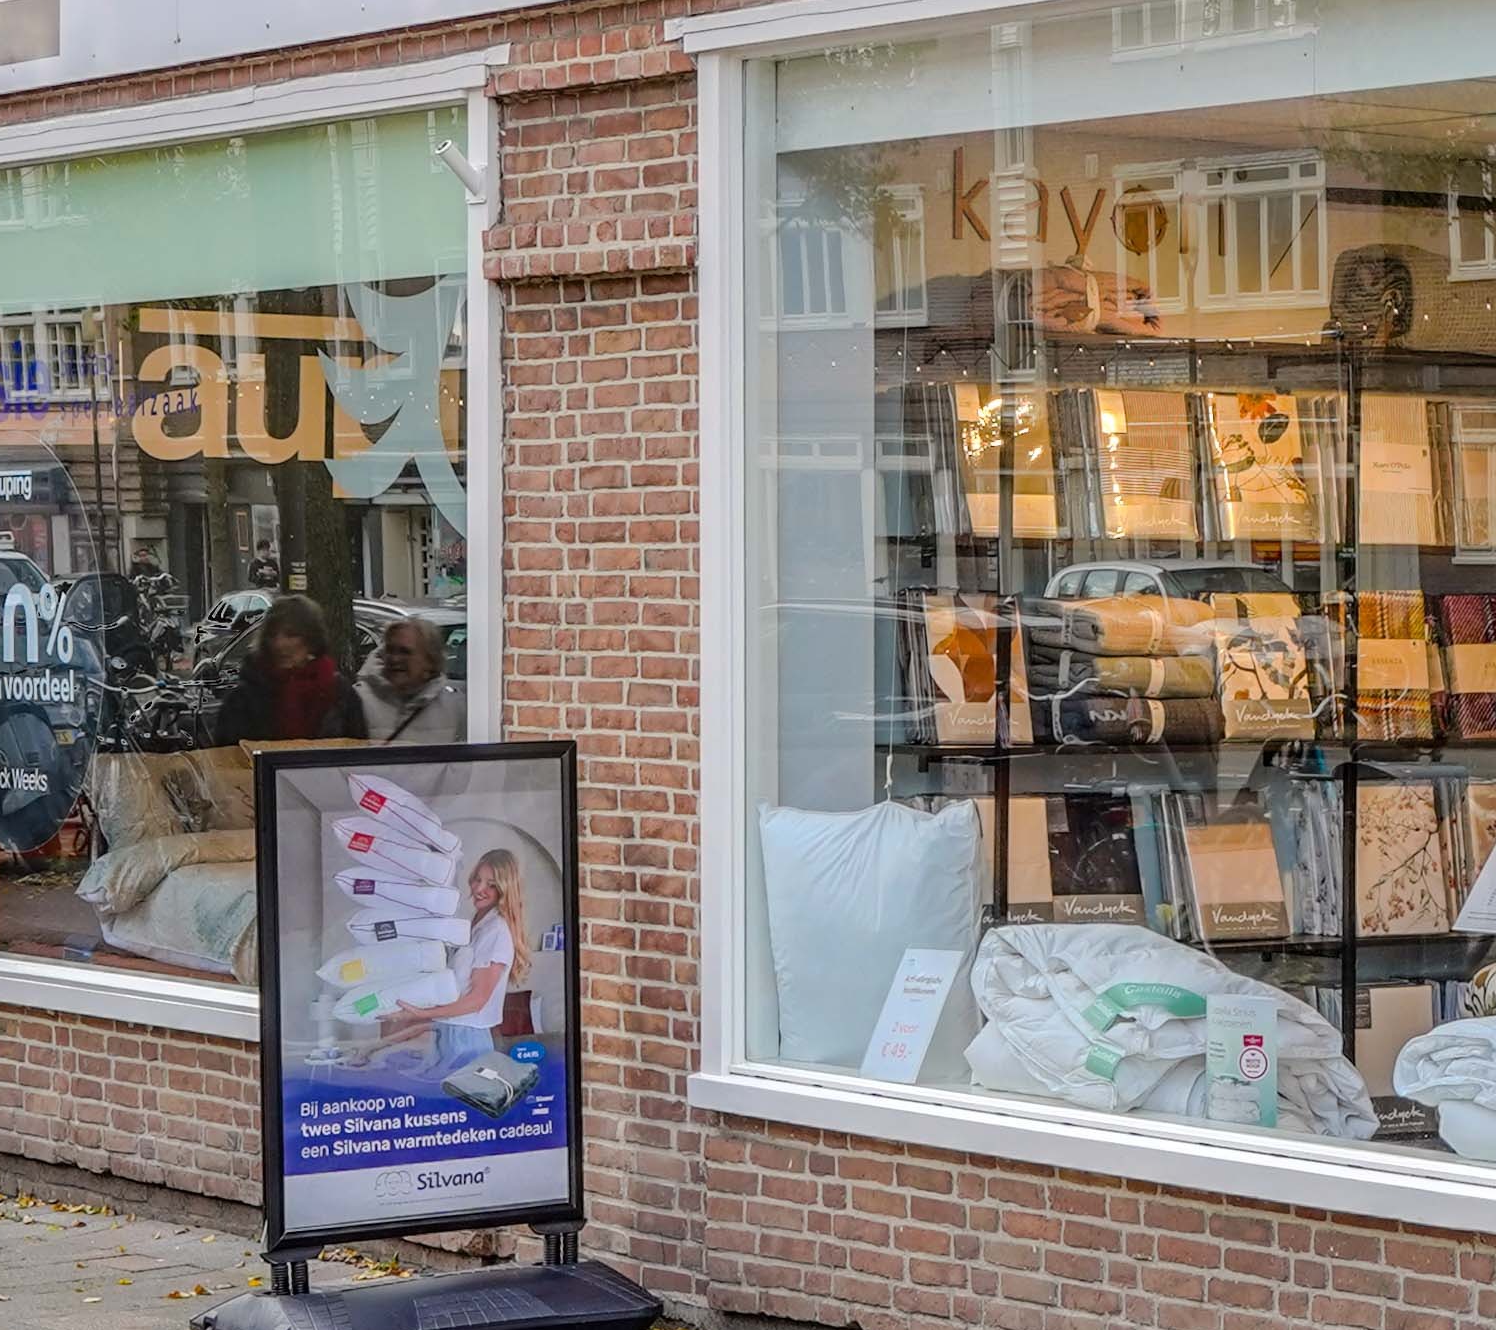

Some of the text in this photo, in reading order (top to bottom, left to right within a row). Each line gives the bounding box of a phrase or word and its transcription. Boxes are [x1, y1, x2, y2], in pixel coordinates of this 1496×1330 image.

[4, 669, 74, 703] voordeel
[12, 768, 48, 792] Weeks
[1064, 895, 1137, 918] Vandyck
[1211, 906, 1278, 927] Vandyck
[300, 1094, 415, 1119] Bij aankoop van
[301, 1109, 467, 1138] twee Silvana kussens
[301, 1120, 553, 1159] een Silvana warmtedeken cadeau!
[416, 1168, 486, 1191] Silvana
